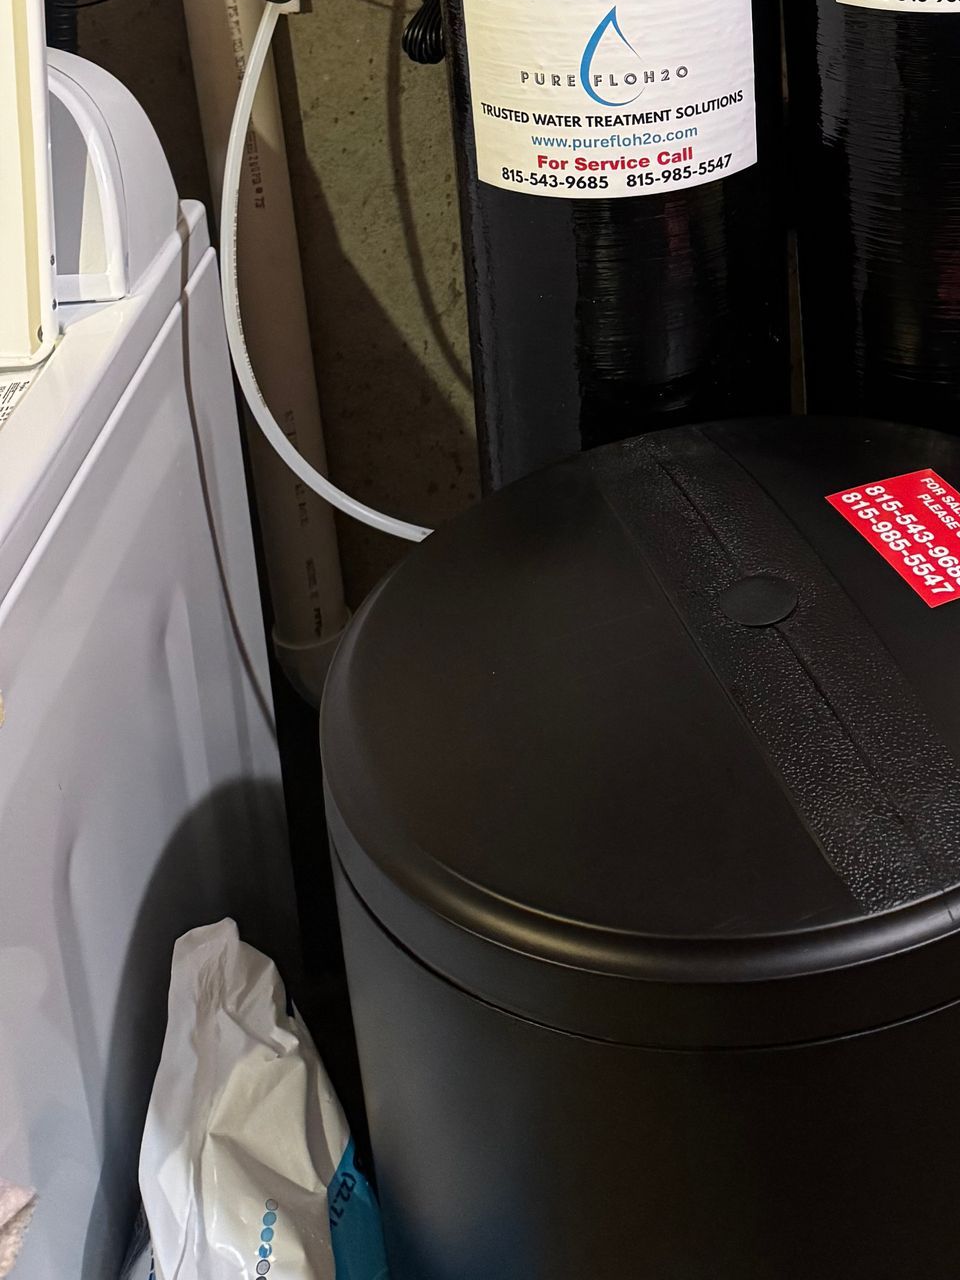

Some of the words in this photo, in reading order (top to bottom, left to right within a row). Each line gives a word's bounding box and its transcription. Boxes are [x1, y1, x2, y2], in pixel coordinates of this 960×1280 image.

[520, 70, 576, 87] PURE
[480, 102, 530, 124] TRUSTED
[532, 113, 583, 128] WATER
[586, 109, 671, 128] TREATMENT
[675, 89, 744, 120] SOLUTIONS
[531, 126, 698, 151] www.purefloh2o.com
[501, 166, 609, 190] 815-543-9685
[626, 152, 733, 188] 815-985-5547
[537, 154, 569, 171] For
[574, 156, 651, 171] Service
[656, 146, 694, 166] Call
[920, 477, 947, 496] FOR
[917, 493, 960, 529] PLEASE
[841, 492, 955, 594] 815-985-5547
